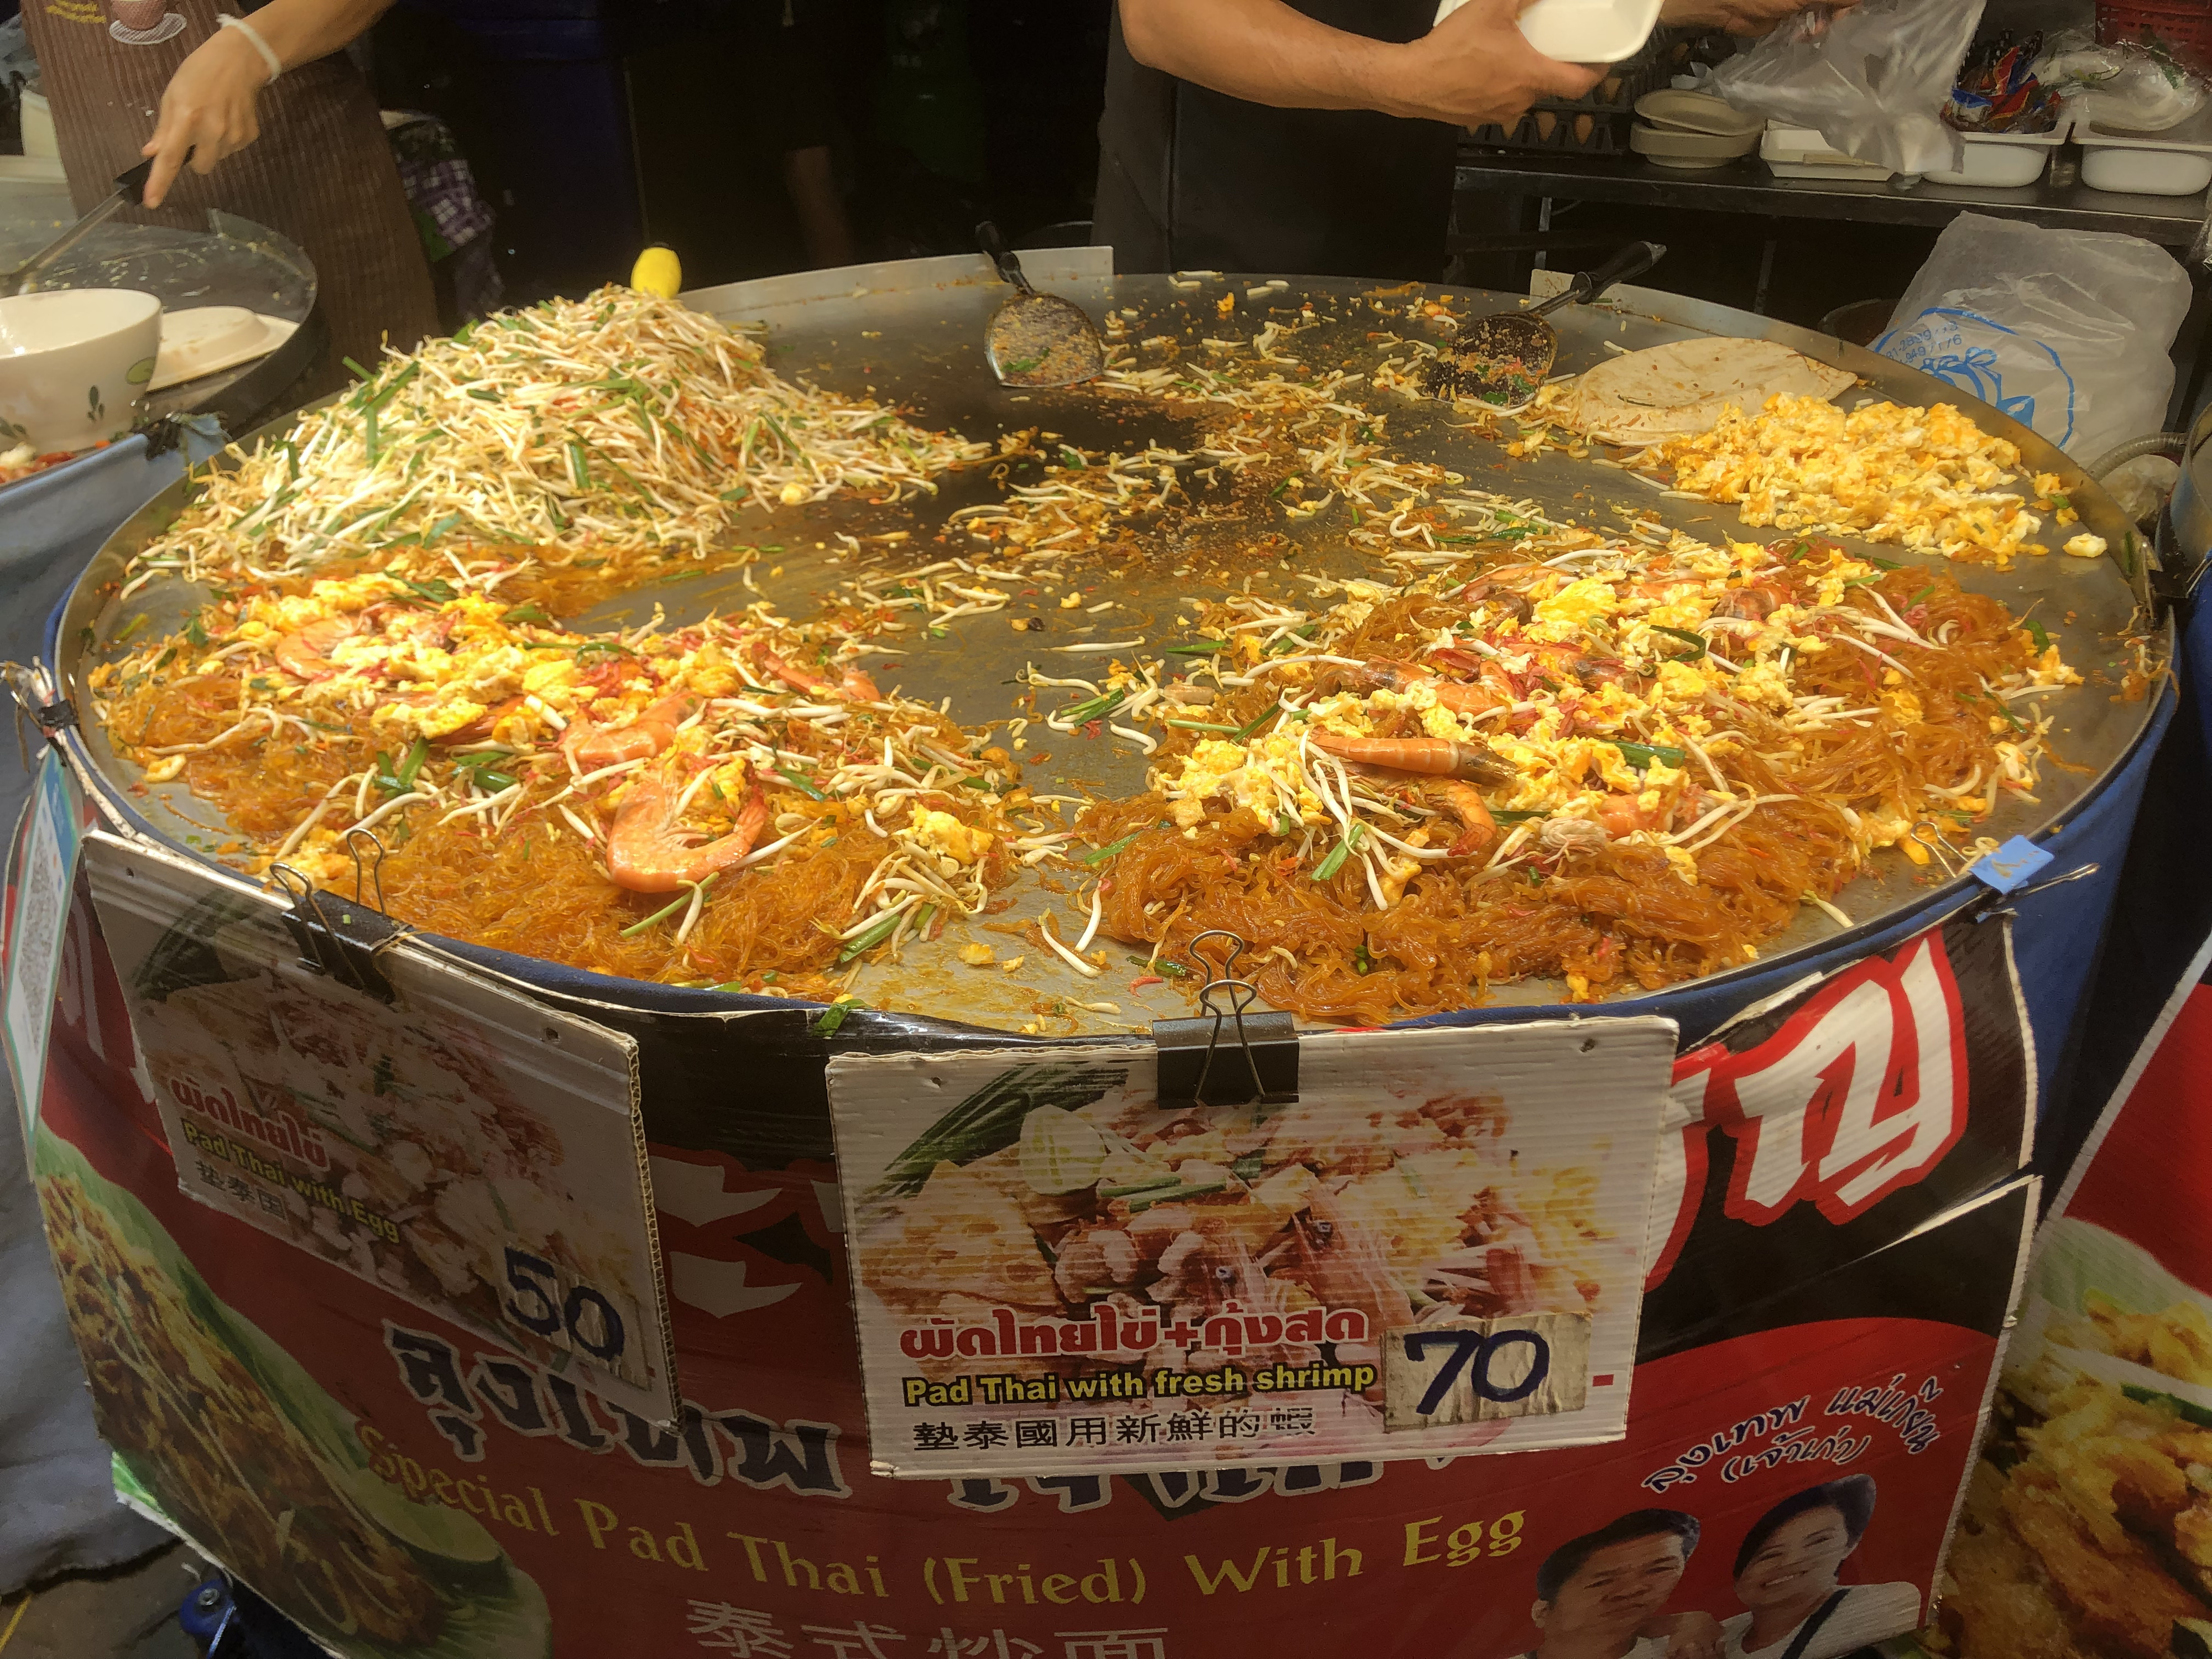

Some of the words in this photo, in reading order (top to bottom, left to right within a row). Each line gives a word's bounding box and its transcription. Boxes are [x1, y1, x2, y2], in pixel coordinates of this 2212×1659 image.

[181, 1118, 230, 1161] Pad
[229, 1140, 285, 1187] Thai
[291, 1175, 346, 1213] with
[351, 1197, 400, 1244] Egg
[503, 1245, 625, 1363] 50
[902, 1375, 972, 1407] Pad
[976, 1373, 1060, 1405] Thai
[1063, 1369, 1147, 1402] with
[1154, 1366, 1247, 1398] fresh
[1253, 1361, 1378, 1393] shrimp
[1405, 1328, 1550, 1416] 70
[913, 1407, 1315, 1451] 墊泰國用新鮮的蝦
[361, 1425, 560, 1536] Special
[574, 1498, 708, 1572] Pad
[726, 1531, 890, 1598] Thai
[923, 1556, 1146, 1605] (Fried)
[1183, 1537, 1364, 1597] With
[1401, 1510, 1527, 1568] Egg
